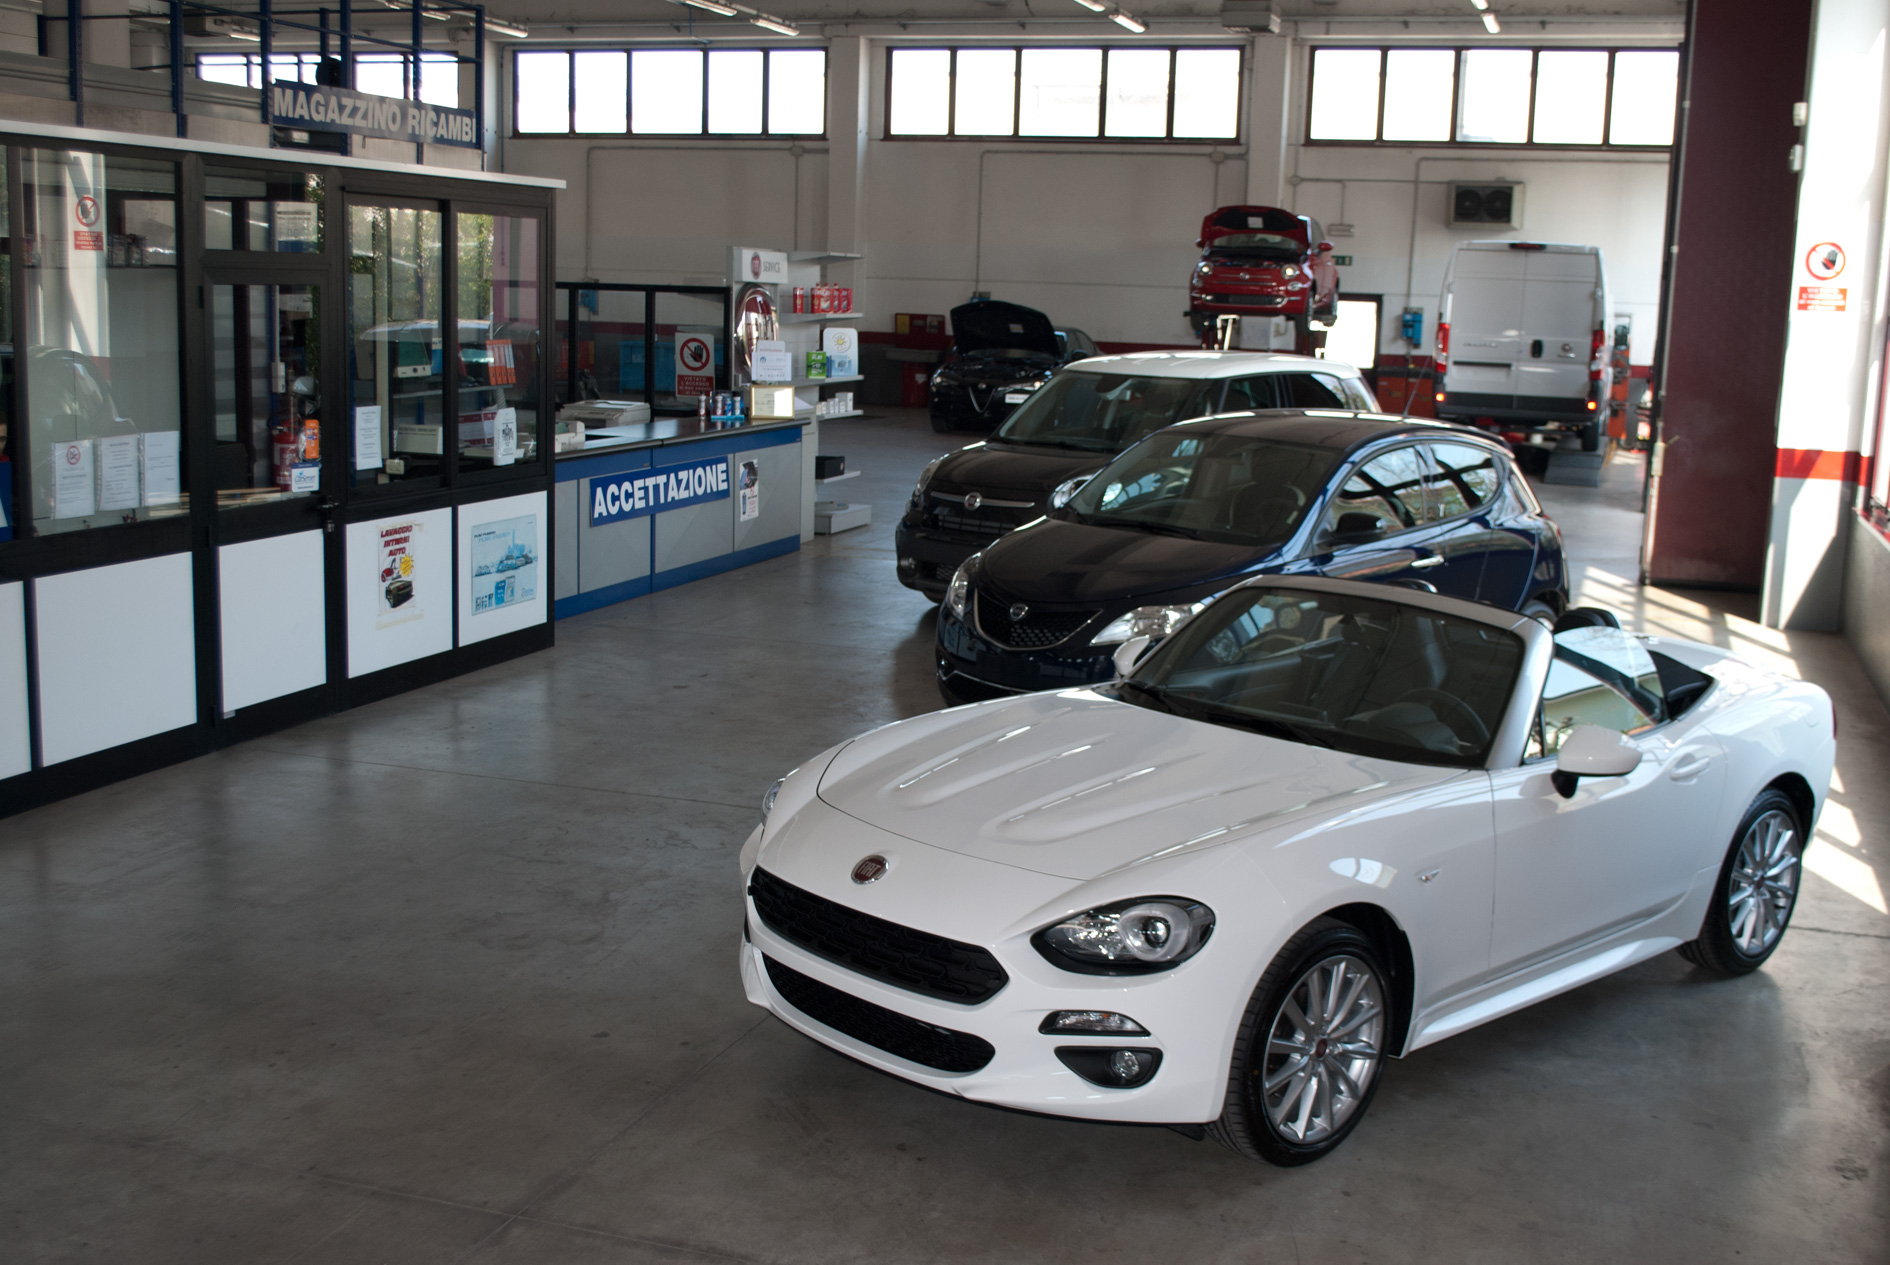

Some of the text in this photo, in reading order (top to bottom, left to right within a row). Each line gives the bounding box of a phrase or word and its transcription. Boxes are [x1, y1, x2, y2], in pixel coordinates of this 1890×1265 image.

[274, 87, 476, 143] MAGAZZINO RICAMBI
[763, 261, 781, 273] SERVICE
[593, 462, 728, 518] ACCETTAZIONE
[380, 525, 413, 538] LAVAGGIO
[388, 547, 406, 557] AUTO
[857, 861, 882, 877] FIAT
